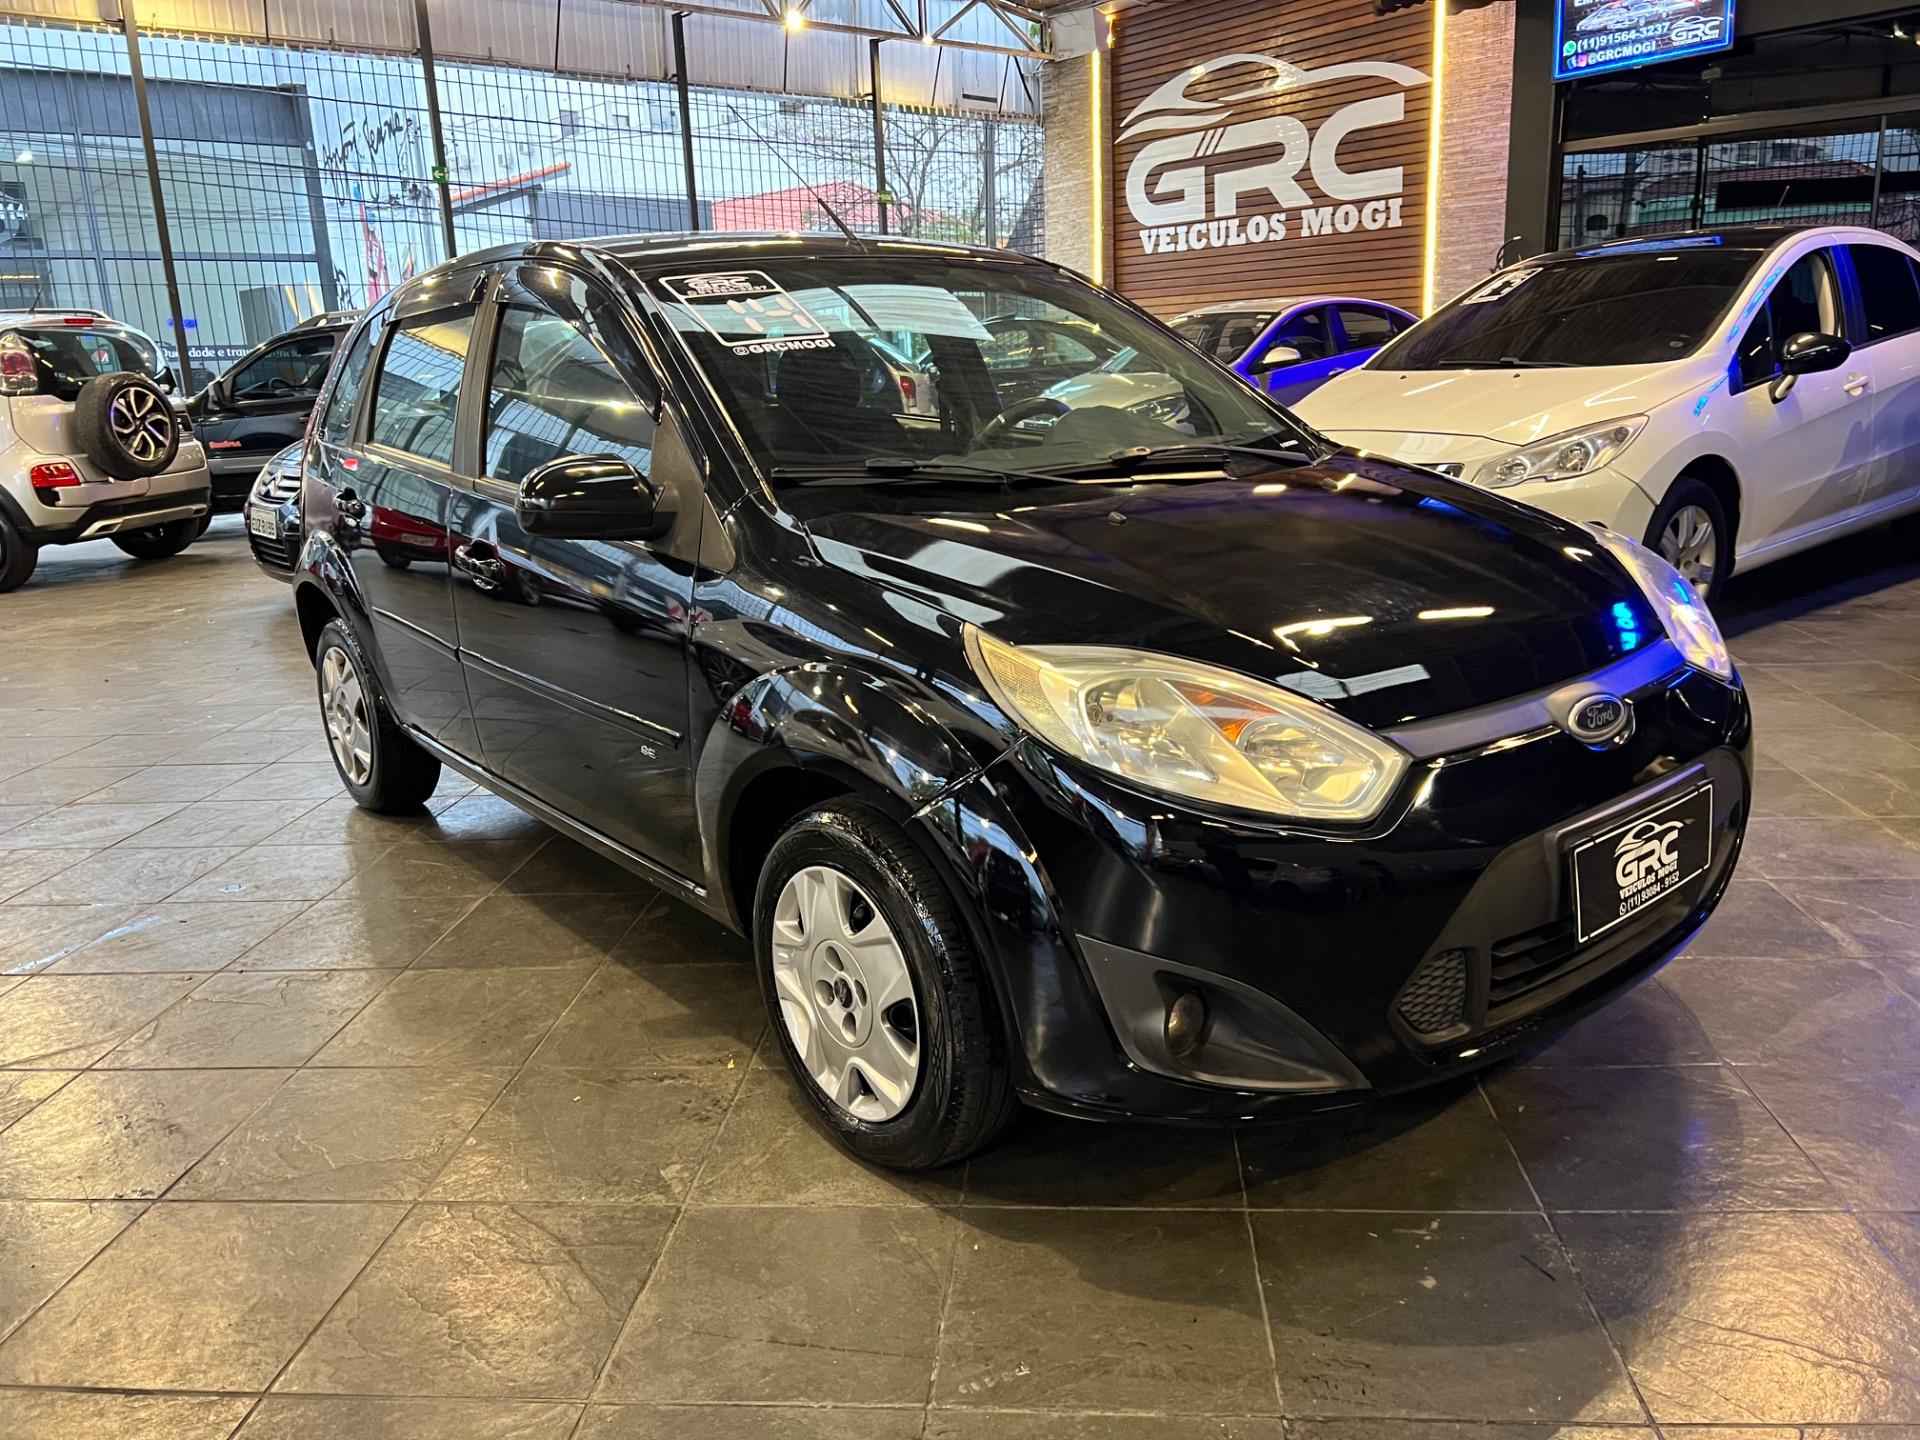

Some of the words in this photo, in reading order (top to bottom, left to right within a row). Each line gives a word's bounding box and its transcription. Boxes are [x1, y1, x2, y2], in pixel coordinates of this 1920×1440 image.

[1578, 22, 1671, 53] (11)91564-3237
[1671, 20, 1720, 42] GRC
[1588, 41, 1656, 65] @GRCMOGI
[1125, 91, 1405, 227] GRC
[1139, 212, 1287, 255] VEICULOS
[1301, 197, 1404, 238] MOGI
[732, 338, 836, 356] @GRCMOGI
[1586, 702, 1615, 729] Ford
[1616, 828, 1679, 888] GRC
[1619, 872, 1656, 900] VEICULOS
[1657, 859, 1678, 880] MOGI
